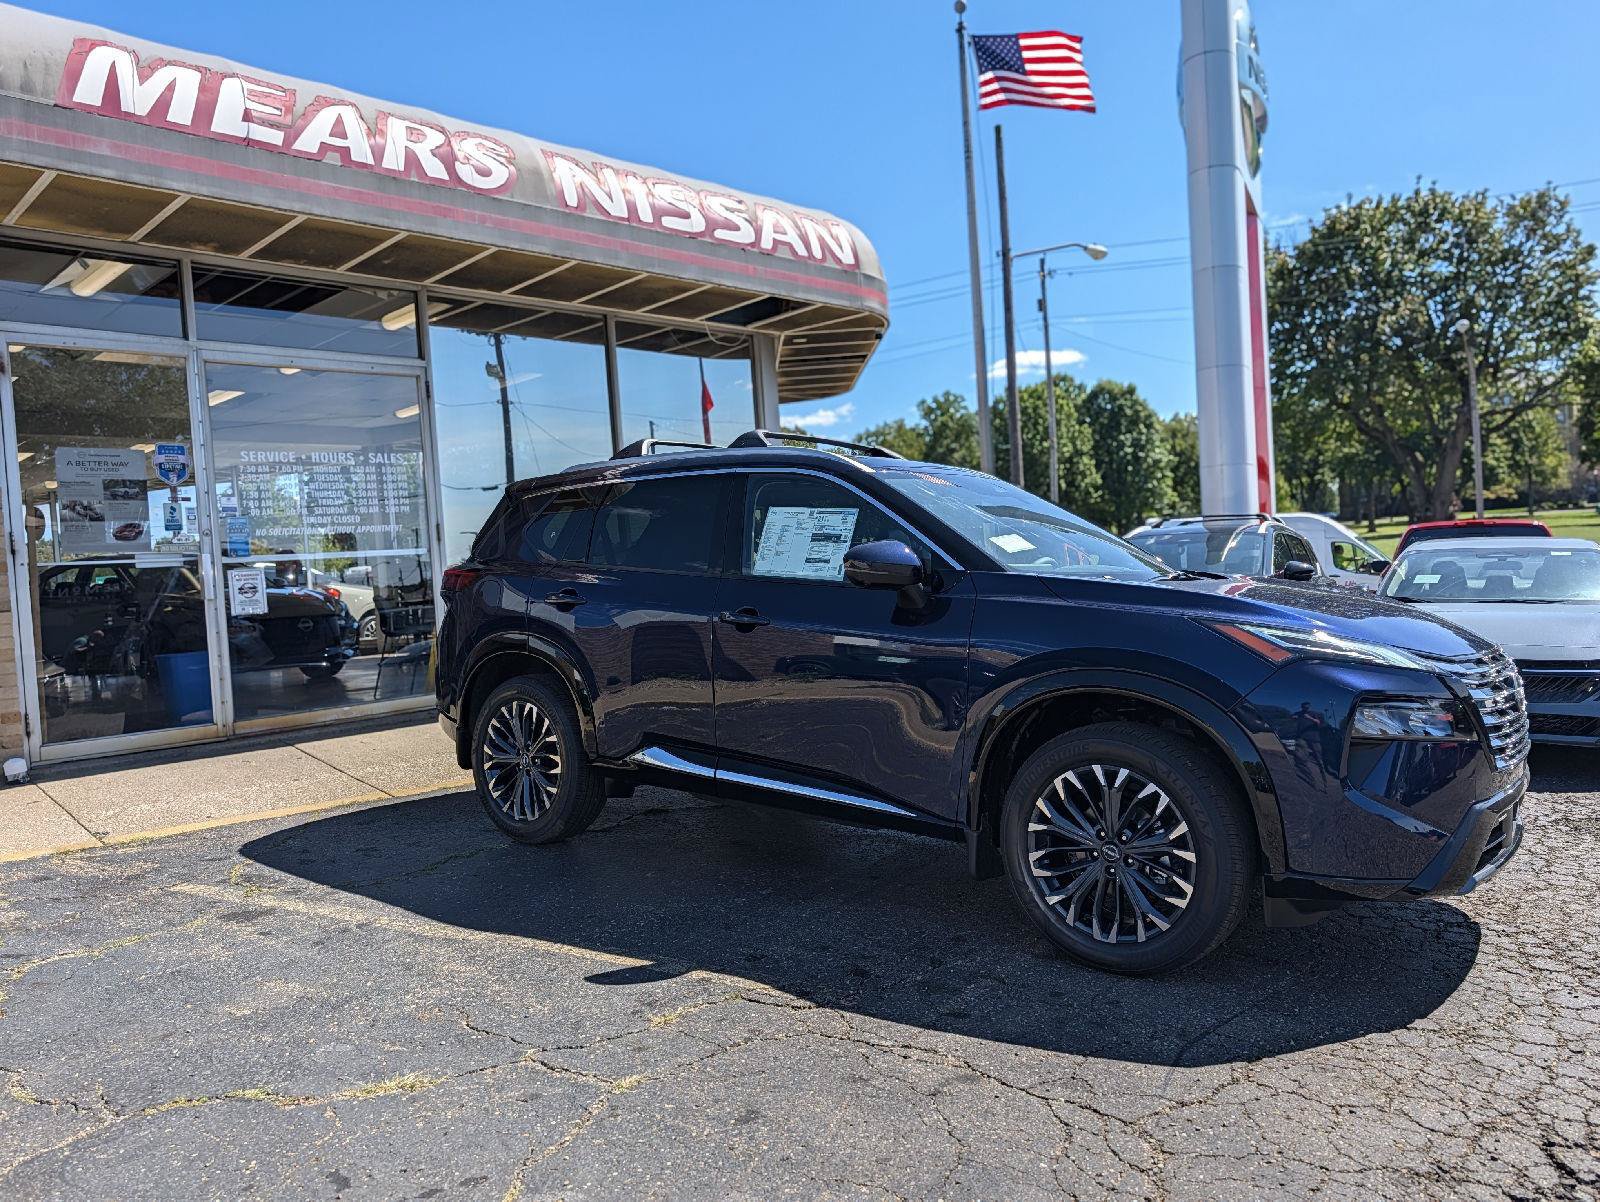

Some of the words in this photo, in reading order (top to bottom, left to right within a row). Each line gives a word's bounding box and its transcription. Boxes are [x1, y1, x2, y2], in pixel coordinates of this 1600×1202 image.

[73, 45, 510, 190] MEARS
[550, 155, 857, 266] NISSAN
[240, 450, 296, 462] SERVICE
[312, 452, 354, 464] HOURS
[368, 453, 404, 464] SALES
[303, 516, 332, 524] SUNDAY
[333, 515, 360, 523] CLOSED
[326, 525, 355, 534] WITHOUT
[356, 524, 402, 533] APPOINTMENT
